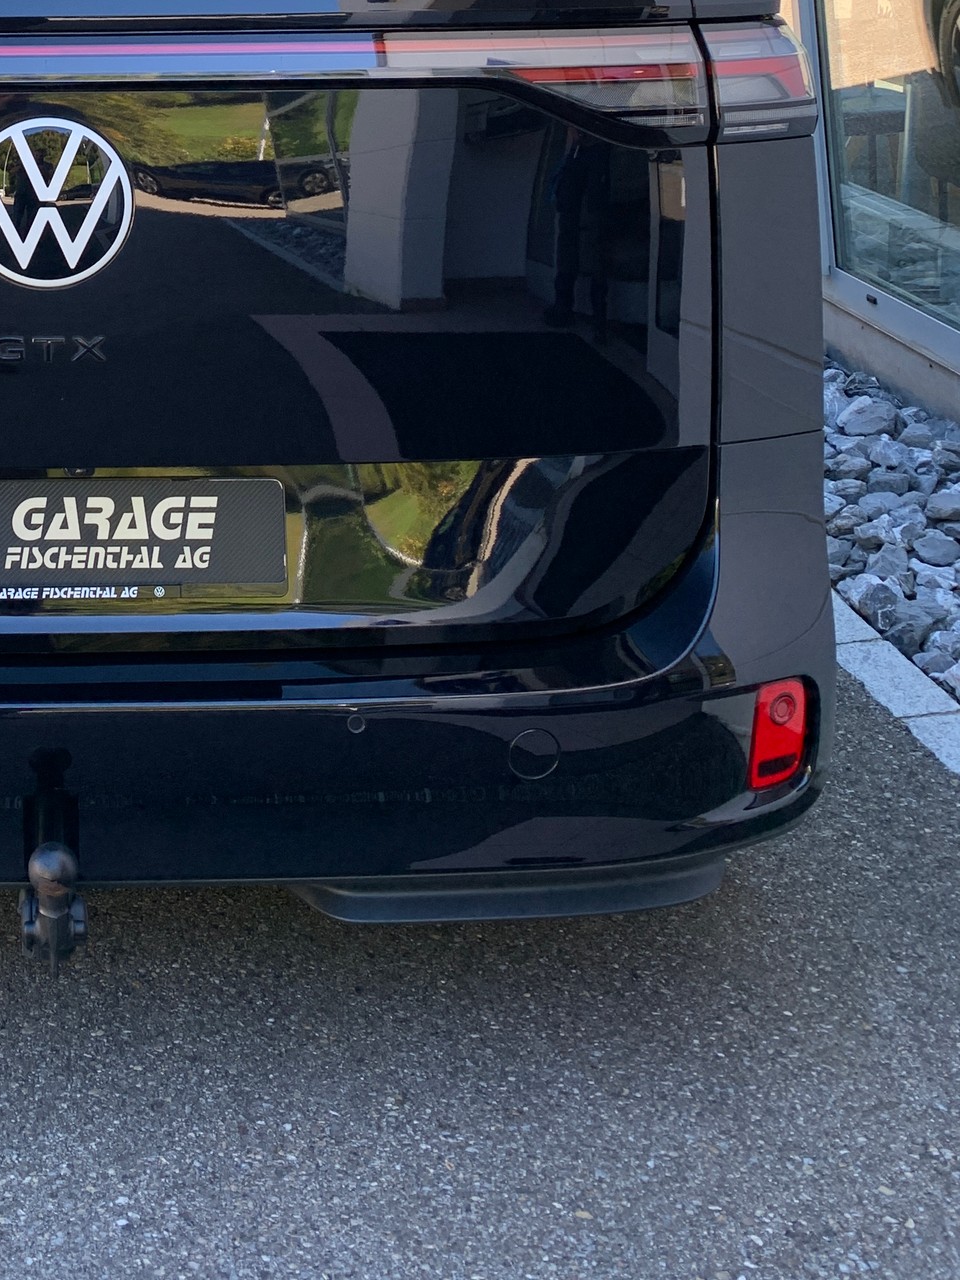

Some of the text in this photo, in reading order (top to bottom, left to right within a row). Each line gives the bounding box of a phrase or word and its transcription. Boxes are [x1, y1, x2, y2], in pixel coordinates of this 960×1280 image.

[12, 496, 219, 541] GARAGE
[4, 546, 212, 570] FISCHENTHAL AG
[42, 587, 117, 599] FISCHENTHAL
[120, 586, 138, 598] AG
